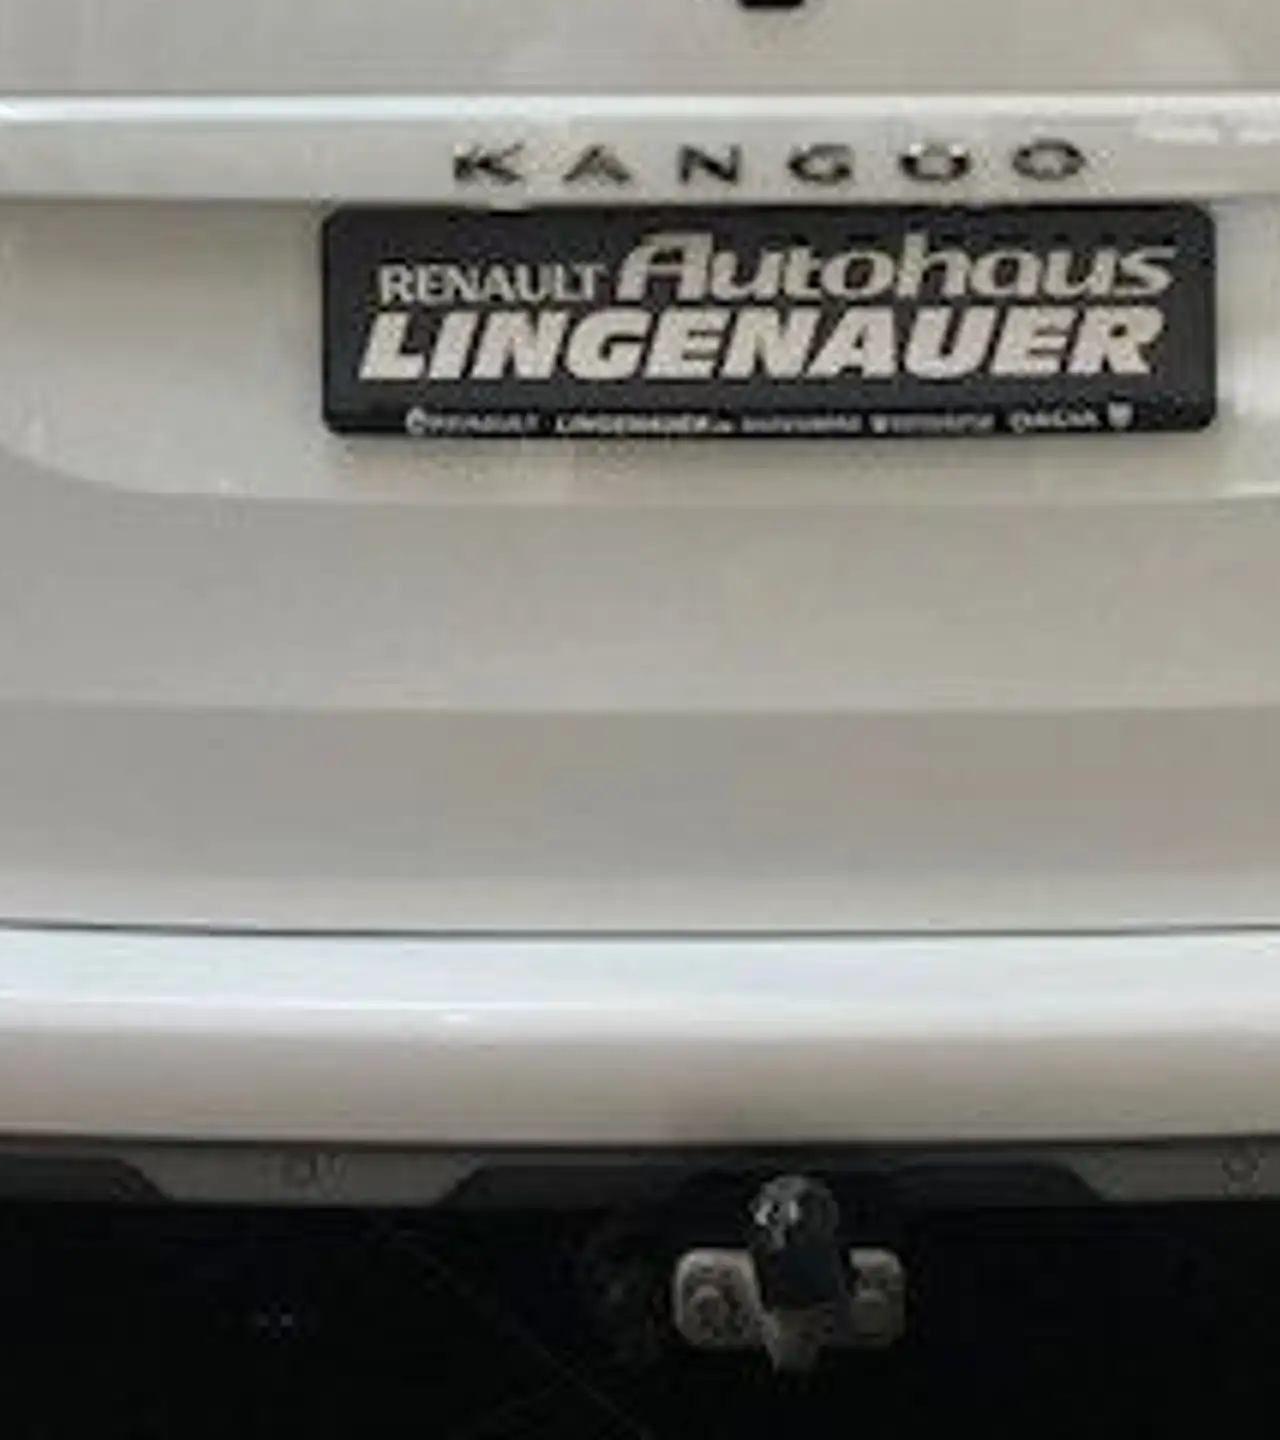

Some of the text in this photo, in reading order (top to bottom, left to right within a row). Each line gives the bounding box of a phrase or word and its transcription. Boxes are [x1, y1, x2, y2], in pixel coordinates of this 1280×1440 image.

[452, 140, 1088, 186] KANGOO
[379, 232, 1176, 305] RENAULT Autohaus
[358, 306, 1166, 382] LINGENAUER
